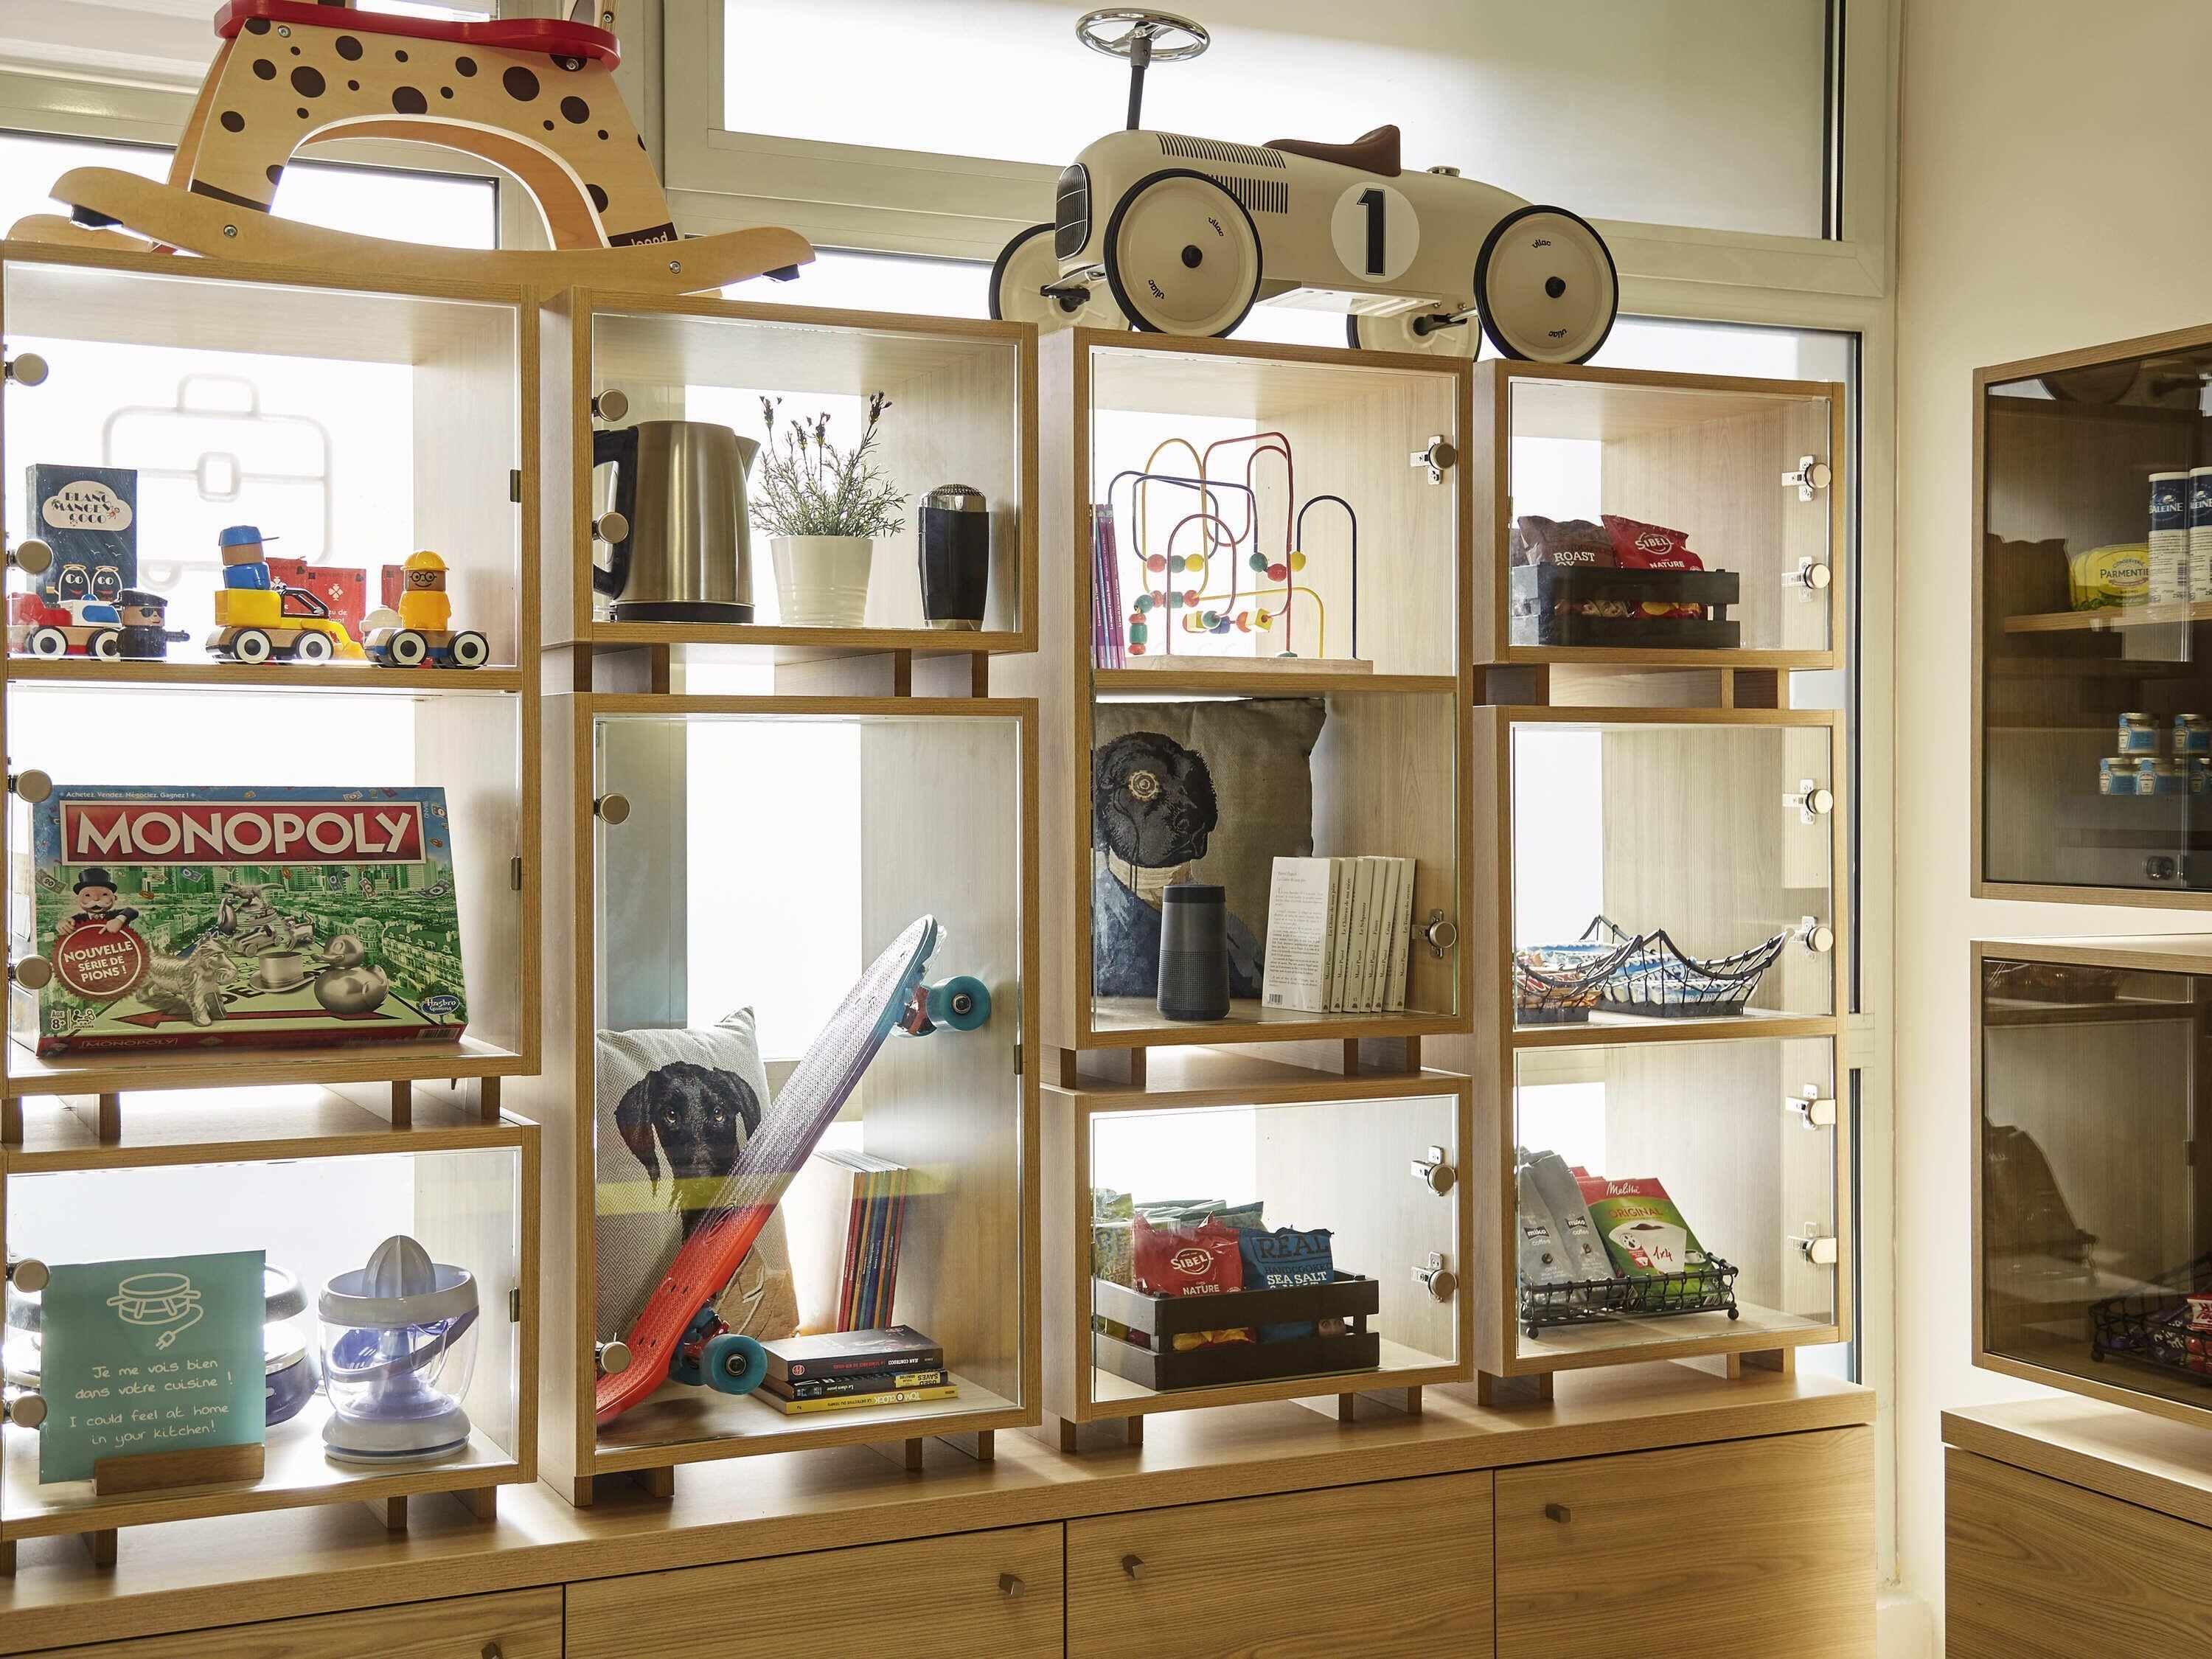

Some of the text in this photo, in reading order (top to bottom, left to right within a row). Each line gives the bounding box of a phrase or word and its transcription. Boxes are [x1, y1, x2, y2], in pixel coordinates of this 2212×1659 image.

[1357, 188, 1385, 276] 1
[1531, 239, 1551, 248] vilac
[65, 492, 109, 503] BLANC
[1554, 552, 1596, 562] ROAST
[1649, 560, 1686, 568] NATURE
[2100, 568, 2149, 579] PARMENTIE
[77, 810, 411, 855] MONOPOLY
[63, 941, 133, 963] NOUVELLE
[78, 956, 125, 972] SÉRIE DE
[81, 967, 120, 983] PIONS
[426, 998, 456, 1007] Hasbro
[1607, 1182, 1640, 1196] Melitta
[1608, 1208, 1663, 1218] ORIGINAL
[1256, 1234, 1329, 1258] REAL
[1267, 1274, 1293, 1285] SEA
[1294, 1271, 1326, 1284] SALT
[1182, 1284, 1220, 1295] NATURE
[92, 1359, 218, 1378] Je me vois bien
[918, 1373, 939, 1381] SAVES
[75, 1386, 111, 1399] dans
[119, 1381, 156, 1395] votre
[164, 1377, 218, 1391] cuisine
[70, 1404, 229, 1428] I could feel at home
[91, 1419, 217, 1448] in your kitchen!
